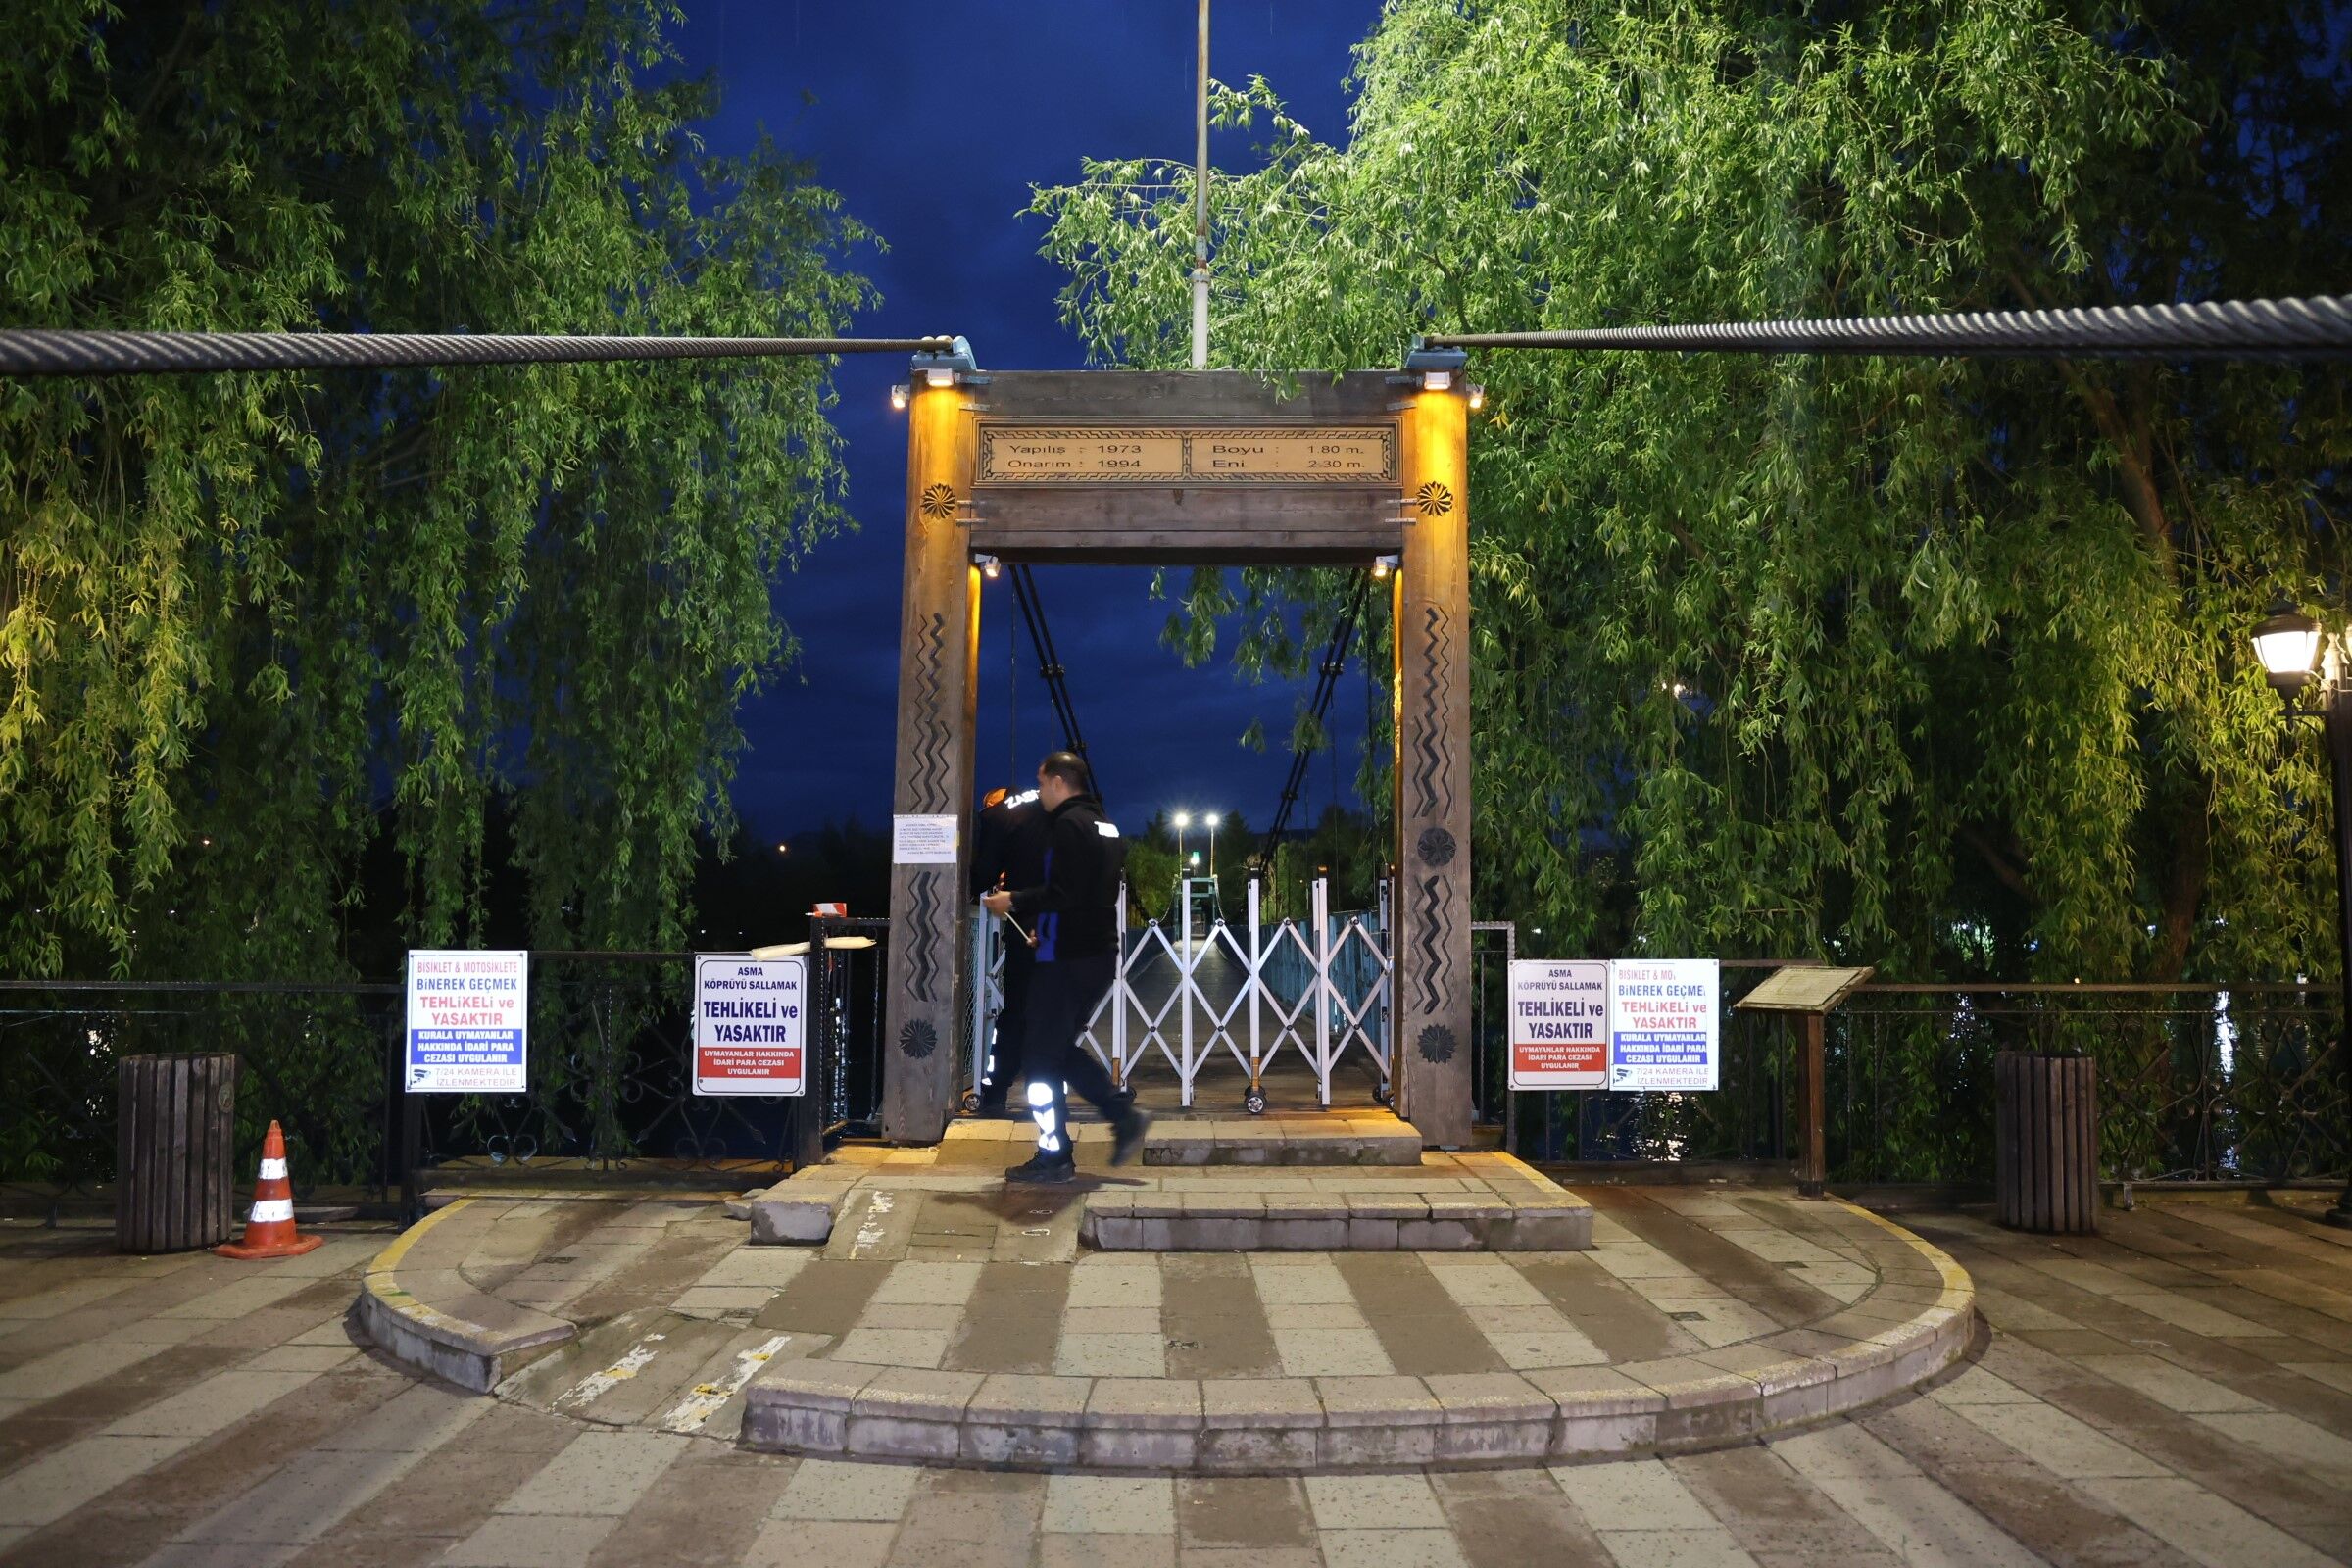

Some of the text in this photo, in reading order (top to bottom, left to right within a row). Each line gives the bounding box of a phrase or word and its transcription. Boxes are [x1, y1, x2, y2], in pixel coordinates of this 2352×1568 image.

[1097, 445, 1142, 454] 1973
[1212, 445, 1264, 455] Boyu
[1097, 460, 1142, 468] 1994
[1212, 460, 1245, 468] Eni
[455, 961, 461, 973] &
[738, 966, 763, 976] ASMA
[1548, 969, 1573, 978] ASMA
[1653, 969, 1658, 981] &
[469, 978, 517, 993] GEÇMEK
[704, 978, 797, 990] KÖPRÜYÜ SALLAMAK
[1559, 982, 1603, 991] SALLAMAK
[498, 999, 514, 1009] ve
[703, 996, 798, 1019] TEHLİKELİ ve
[1518, 997, 1604, 1017] TEHLİKELİ ve
[1692, 1004, 1707, 1013] ve
[432, 1012, 503, 1026] YASAKTIR
[1633, 1017, 1697, 1029] YASAKTIR
[418, 1031, 514, 1040] KURALA UYMAYANLAR
[714, 1024, 786, 1042] YASAKTIR
[1529, 1022, 1593, 1039] YASAKTIR
[1620, 1033, 1706, 1042] KURALA UYMAYANLAR
[417, 1040, 514, 1052] HAKKINDA İDARİ PARA
[1620, 1042, 1706, 1053] HAKKINDA İDARİ PARA
[423, 1054, 508, 1063] CEZASI UYGULANIR
[713, 1057, 734, 1066] İDARİ
[1626, 1054, 1701, 1063] CEZASI UYGULANIR
[435, 1067, 455, 1076] 7/24
[457, 1067, 499, 1076] KAMERA
